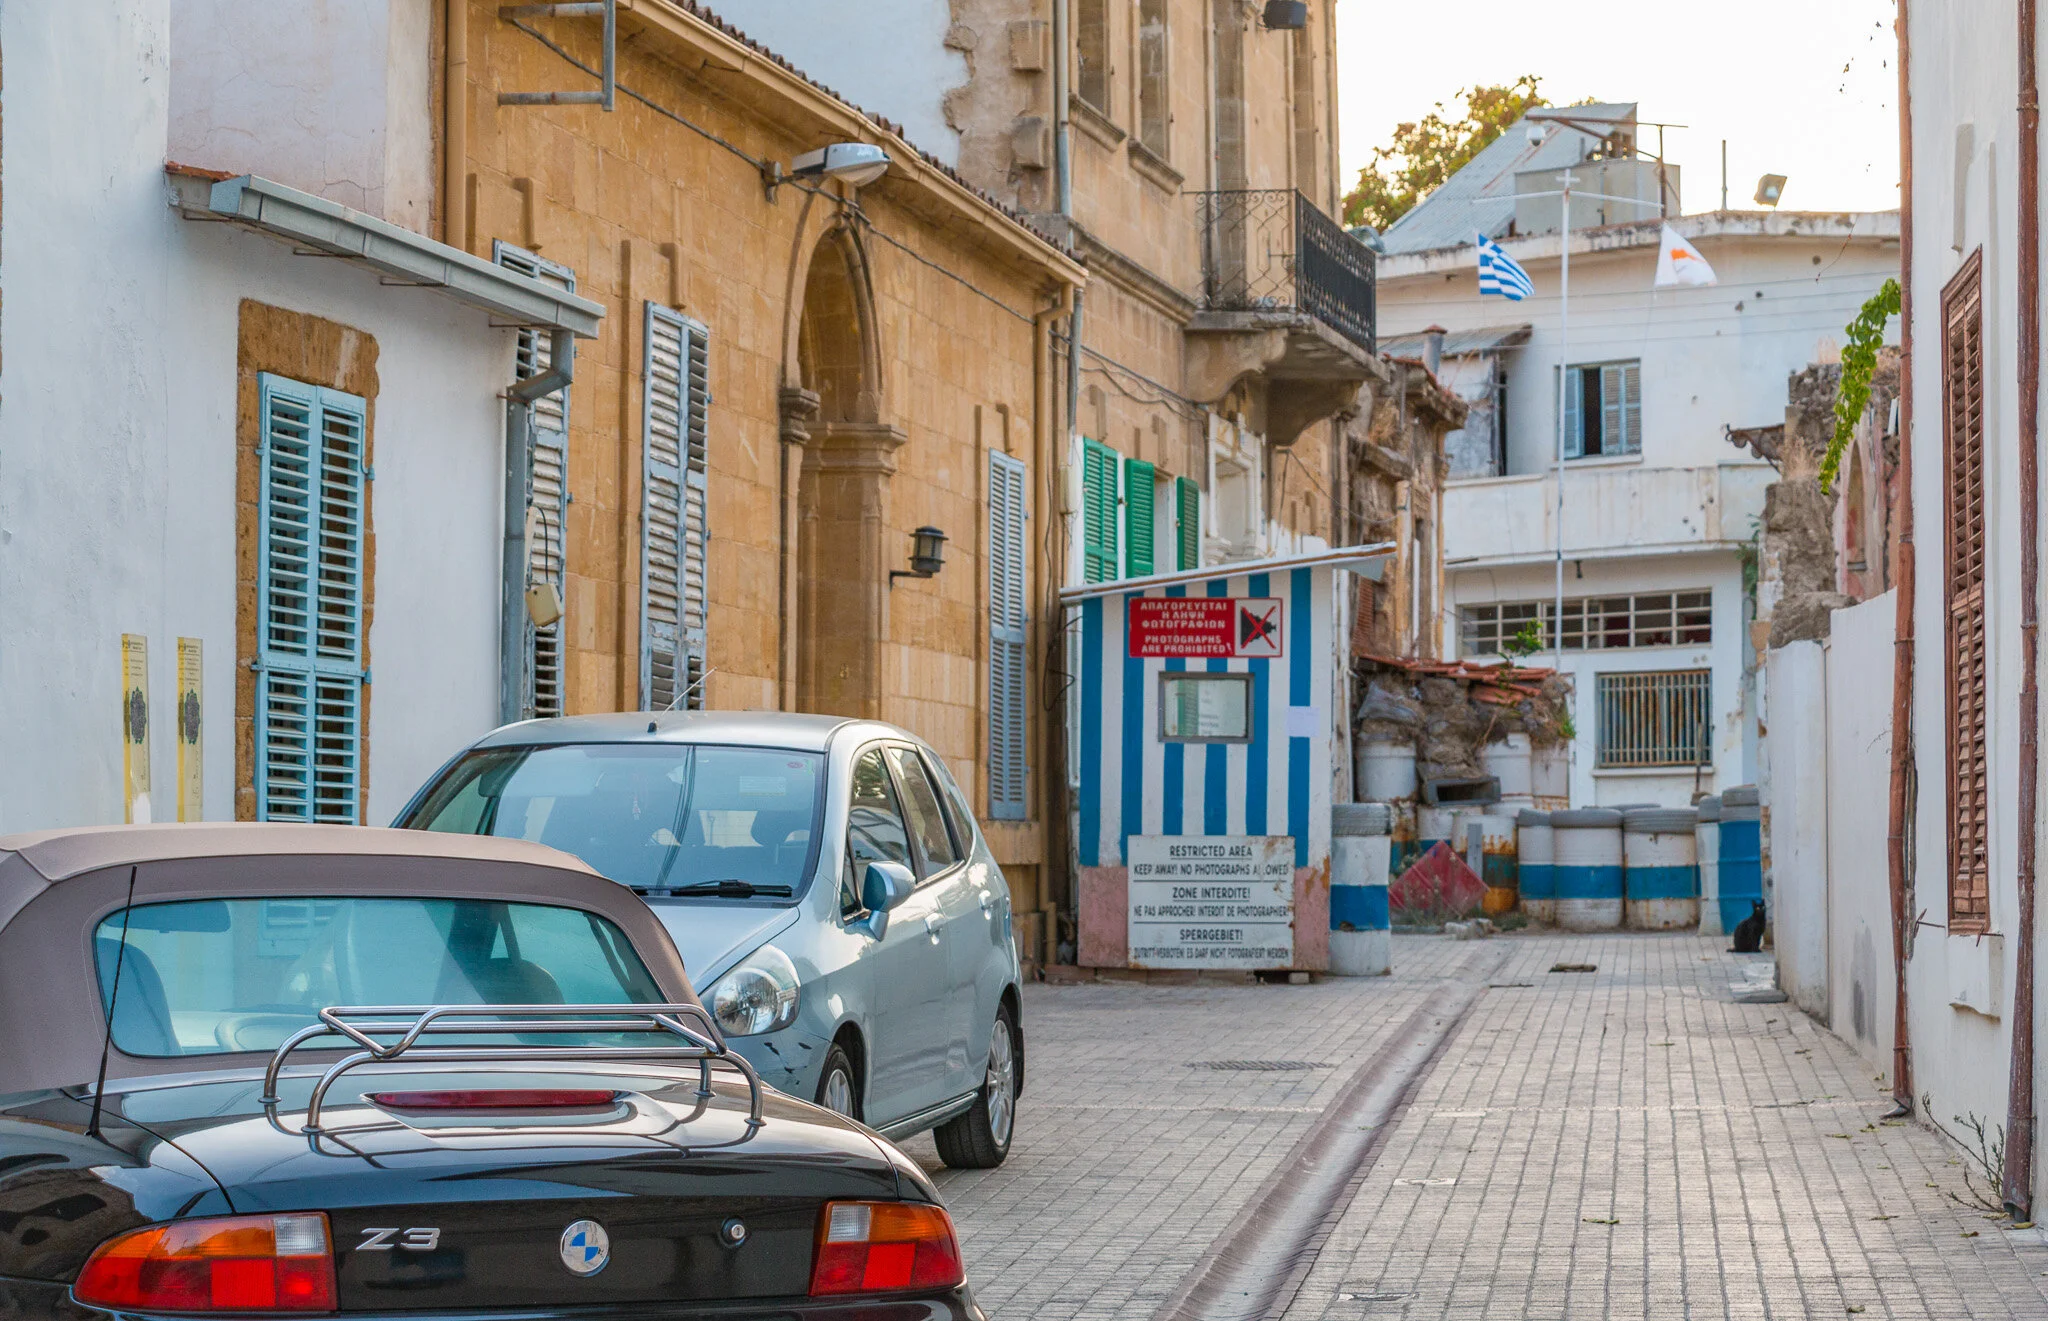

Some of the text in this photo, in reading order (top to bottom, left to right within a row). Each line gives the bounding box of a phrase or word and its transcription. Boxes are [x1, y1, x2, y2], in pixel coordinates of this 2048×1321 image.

[1140, 602, 1227, 610] ΑΠΑΓΟΡΕΥΕΤΑΙ
[1162, 611, 1205, 619] Η ΛΗΨΗ
[1142, 620, 1226, 628] ΦΩΤΟΓΡΑΦΙΩΝ
[1145, 635, 1221, 643] PHOTOGRAPHS
[1142, 645, 1226, 653] ARE PROHIBITED
[1170, 845, 1253, 857] RESTRICTED AREA
[1134, 864, 1152, 875] KEEP
[1155, 864, 1178, 875] AWAY!
[1181, 864, 1192, 875] NO
[1195, 864, 1250, 875] PHOTOGRAPHS
[1172, 887, 1250, 899] ZONE INTERDITE!
[1134, 905, 1142, 916] NE
[1144, 905, 1156, 916] PAS
[1198, 905, 1224, 916] INTERDIT
[1227, 905, 1235, 916] DE
[1179, 929, 1243, 941] SPERRGEBIET!
[1187, 947, 1193, 958] ES
